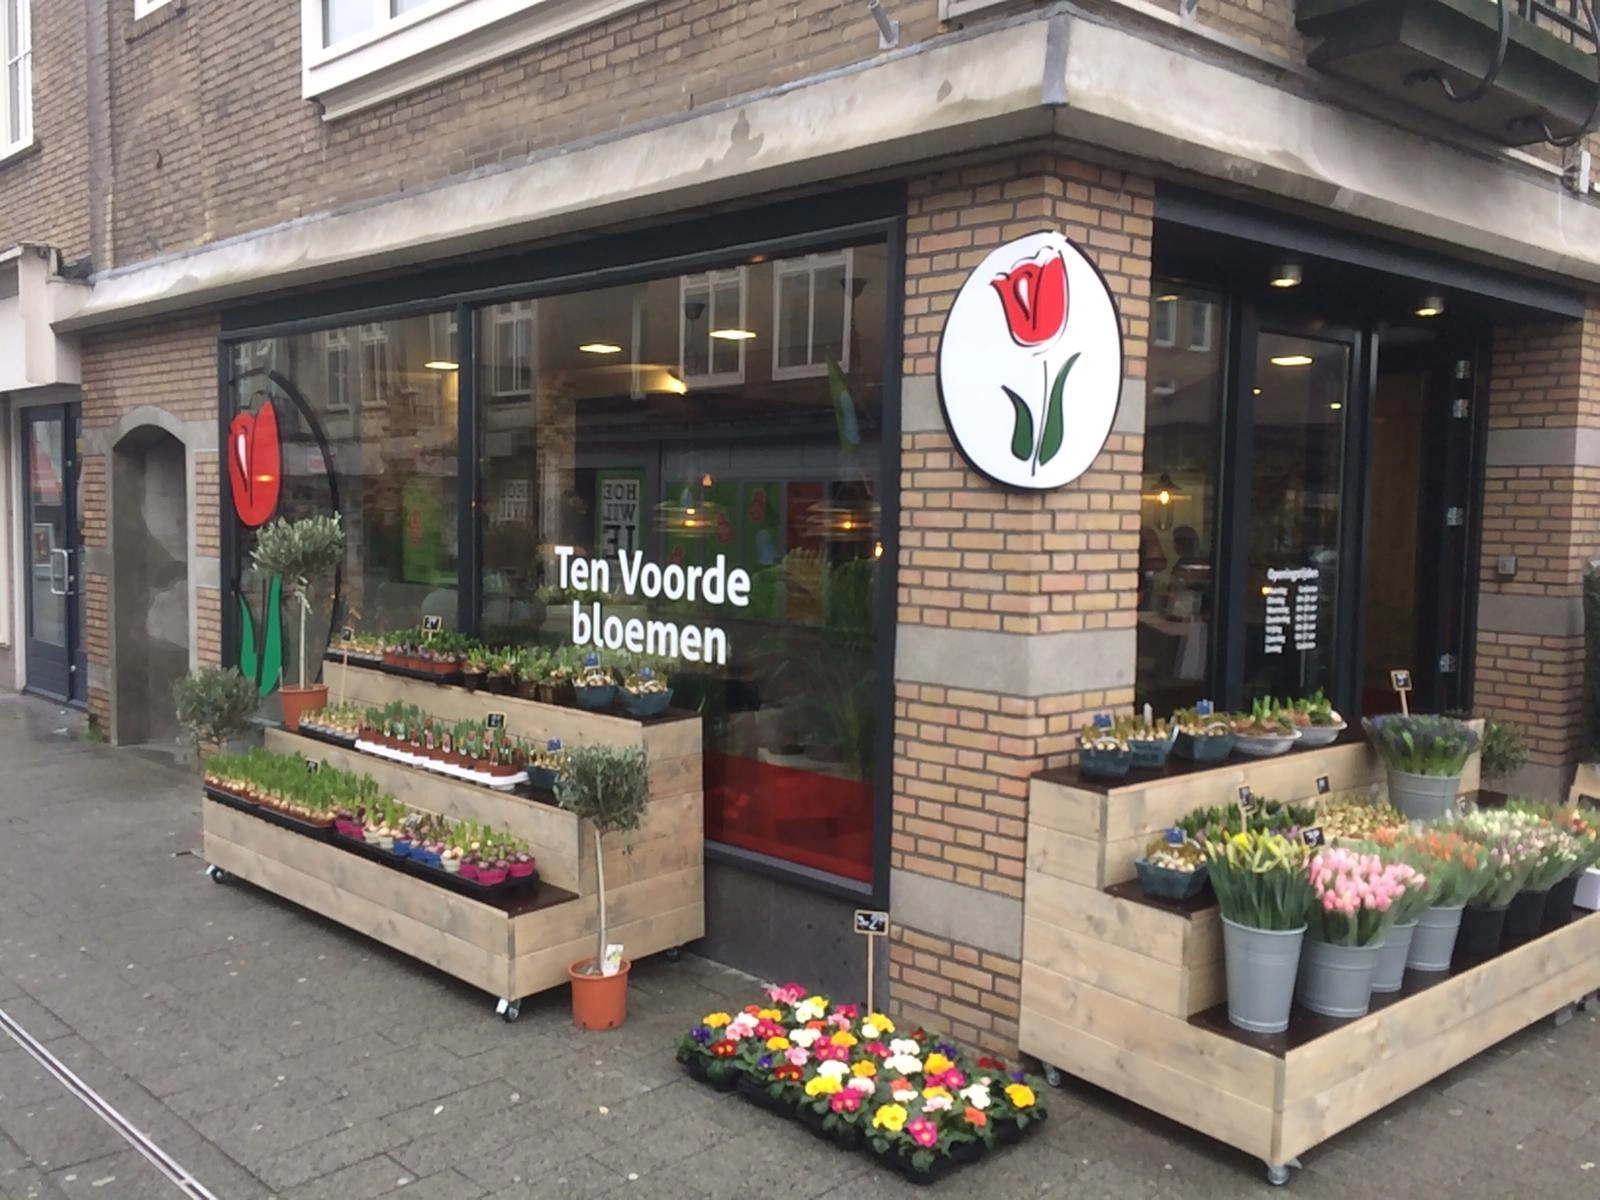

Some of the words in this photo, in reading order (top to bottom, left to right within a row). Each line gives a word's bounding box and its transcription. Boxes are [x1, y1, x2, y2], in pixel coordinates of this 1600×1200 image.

[554, 545, 610, 593] Ten
[617, 549, 751, 607] Voorde
[572, 599, 727, 666] bloemen
